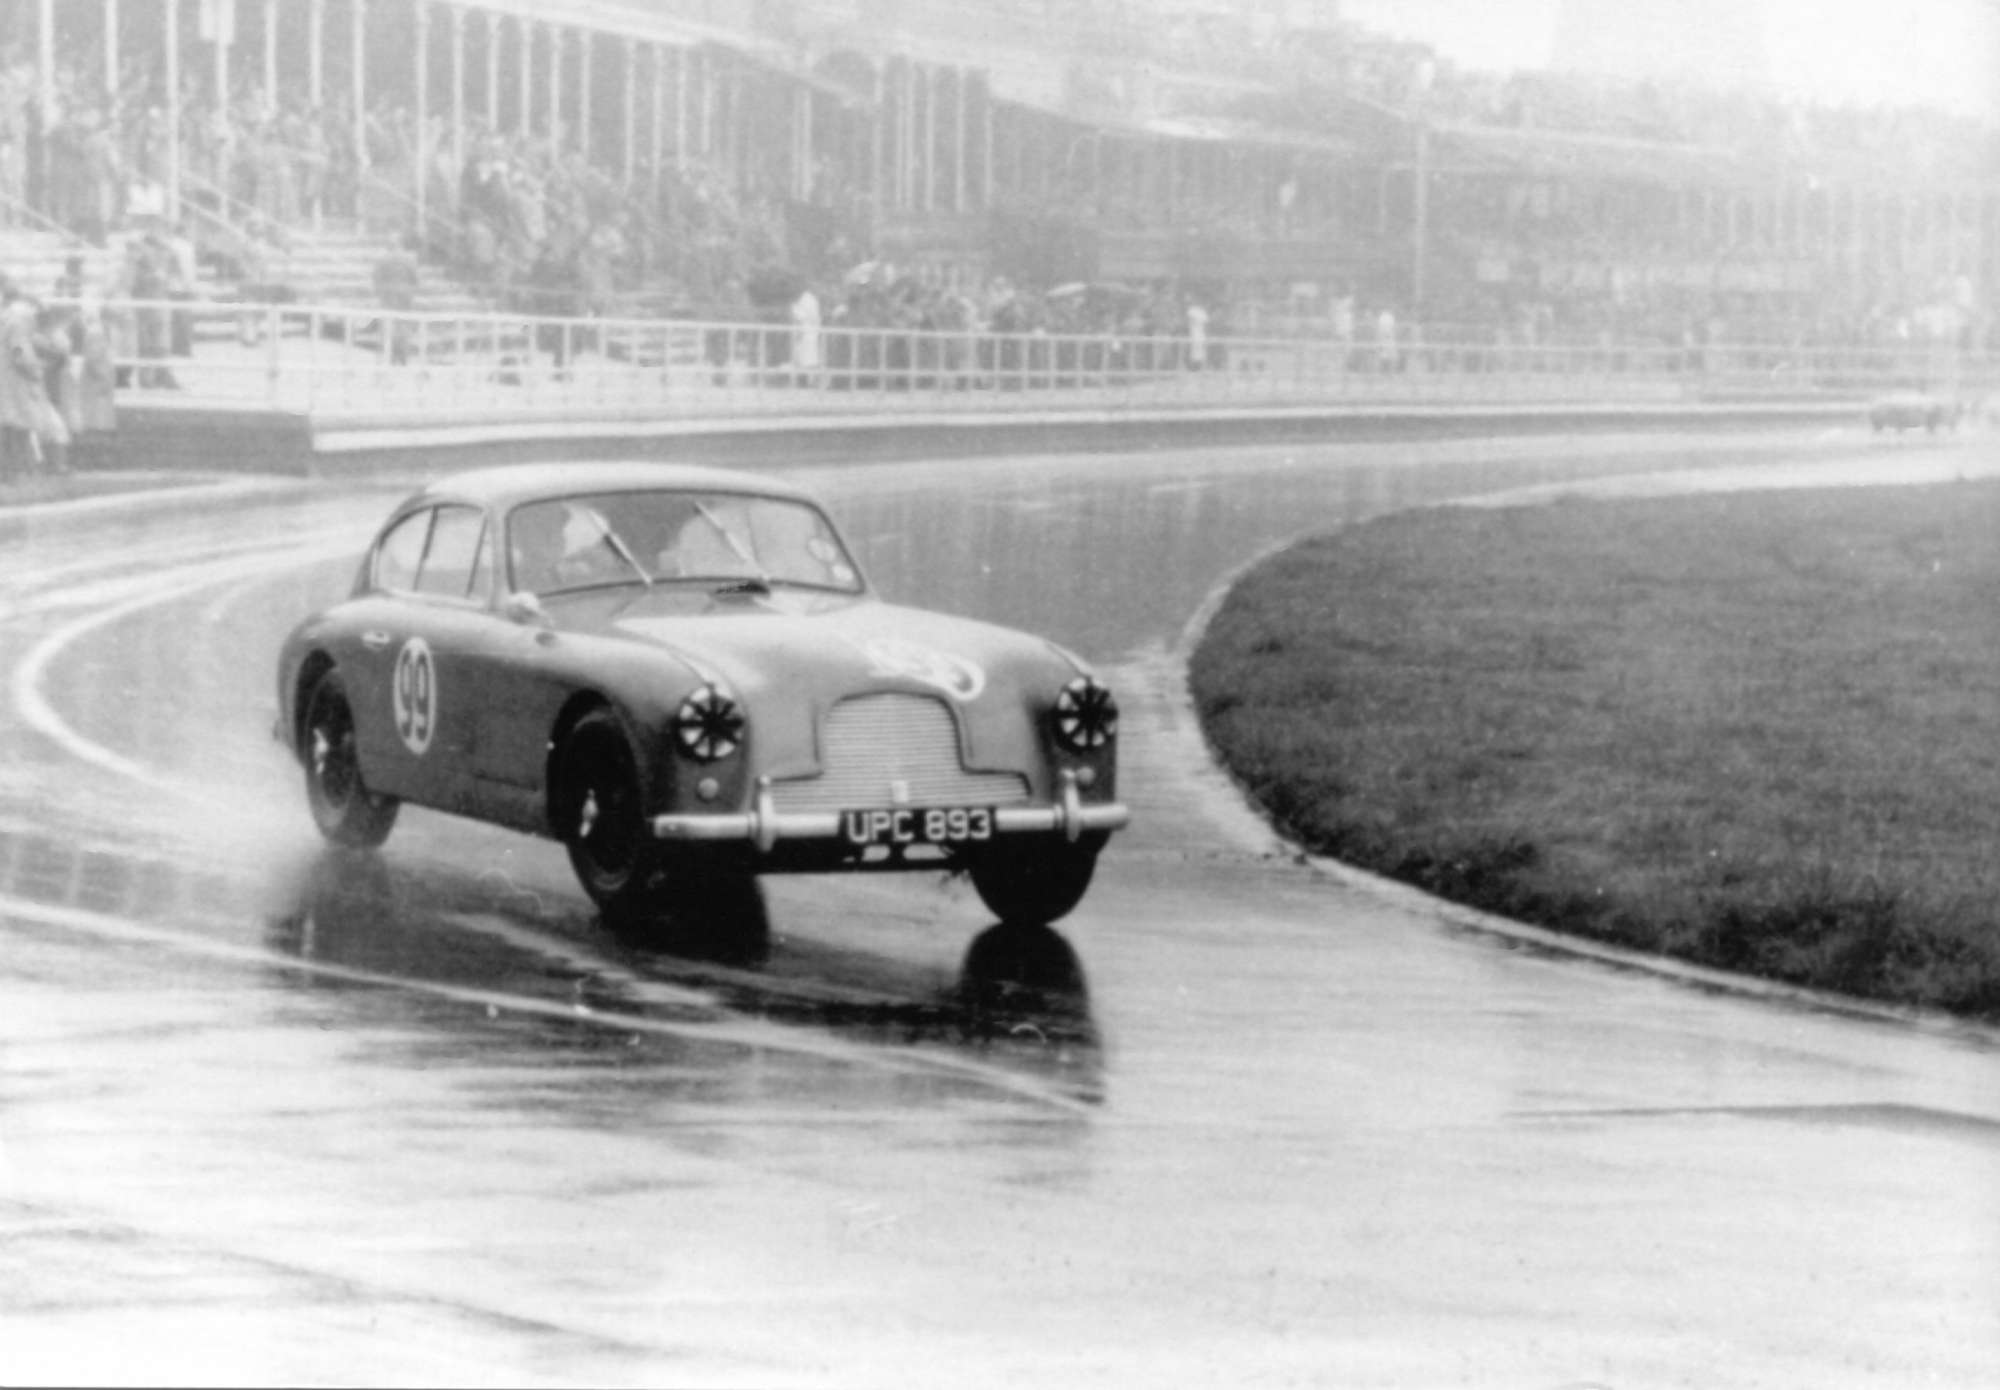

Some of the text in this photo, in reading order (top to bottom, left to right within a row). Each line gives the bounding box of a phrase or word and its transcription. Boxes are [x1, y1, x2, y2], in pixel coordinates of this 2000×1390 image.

[399, 647, 430, 742] 99
[848, 808, 990, 842] UPC 893
